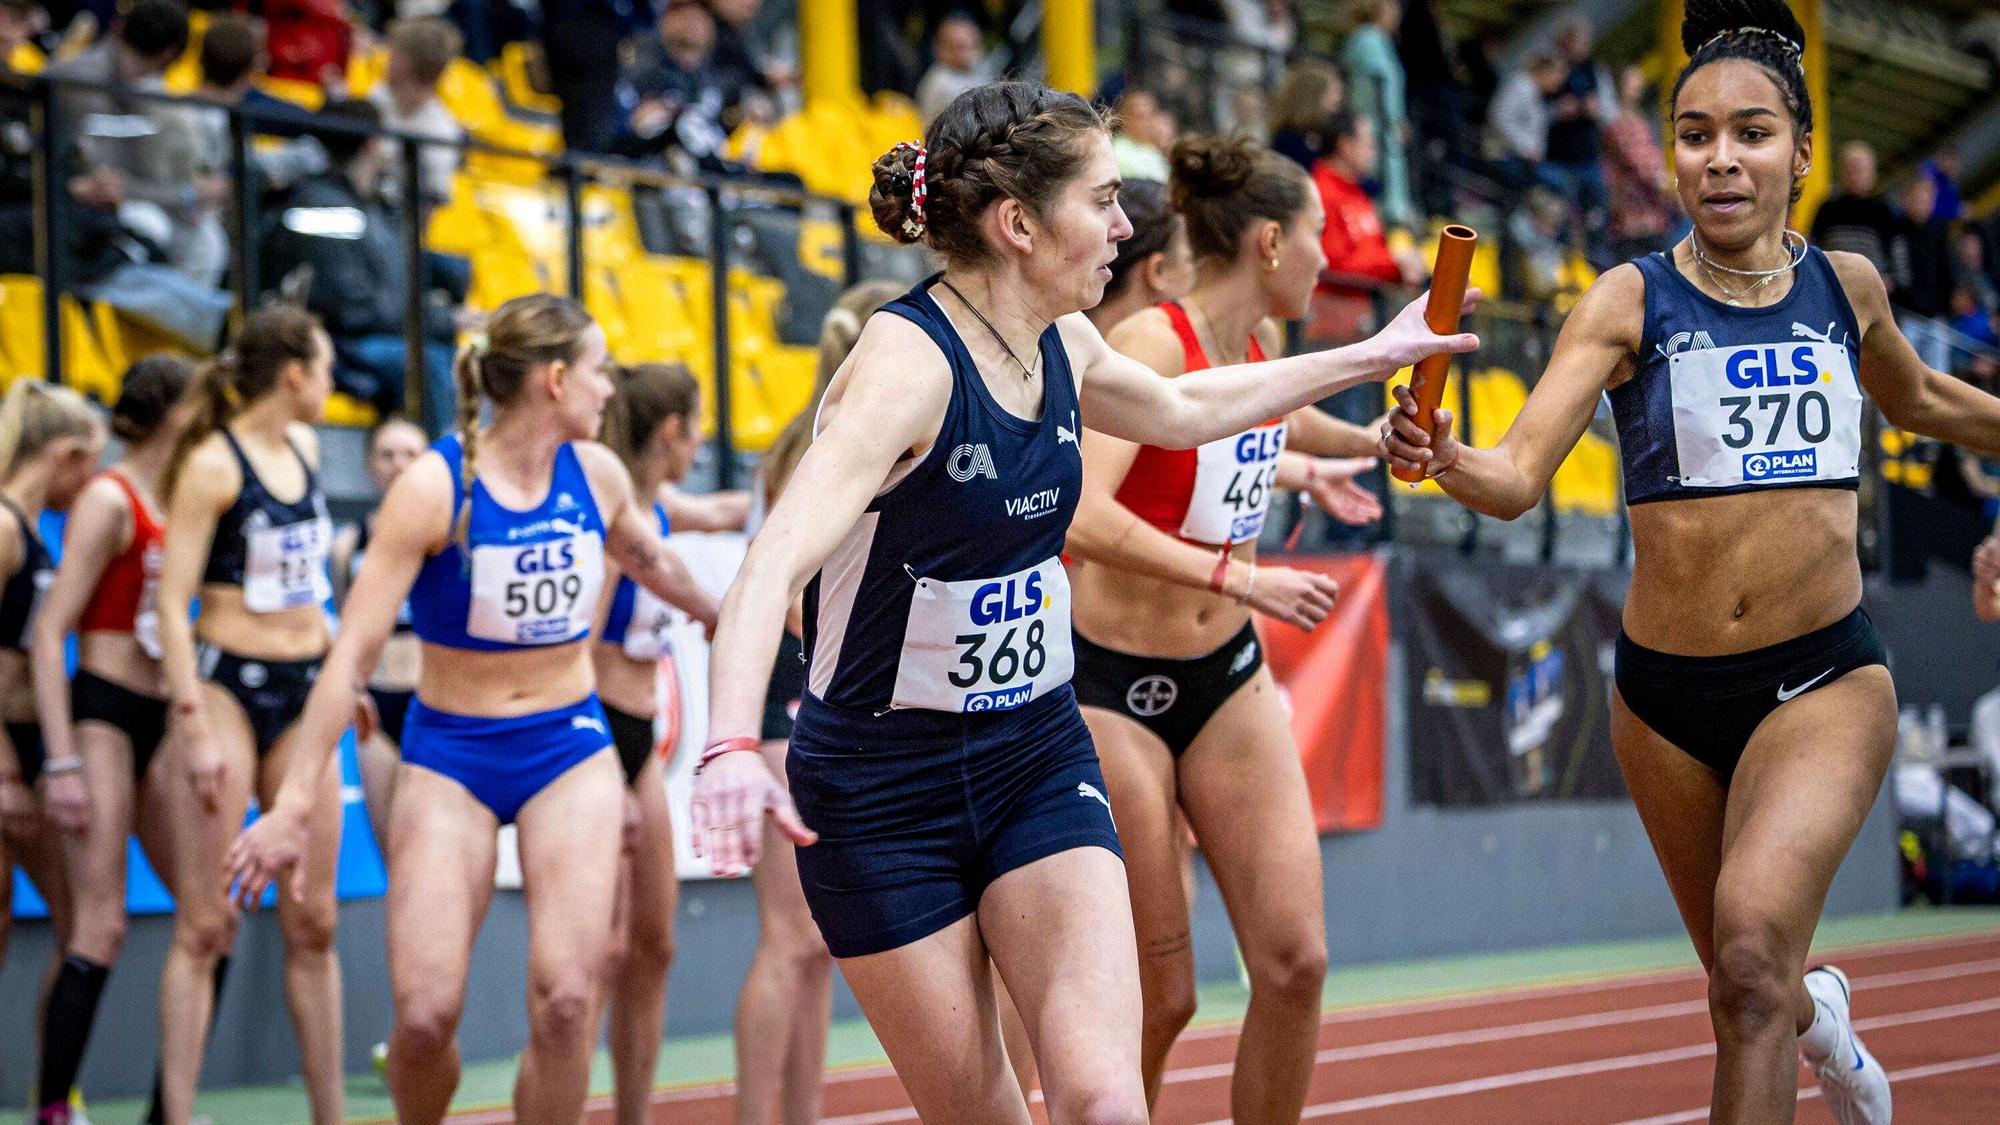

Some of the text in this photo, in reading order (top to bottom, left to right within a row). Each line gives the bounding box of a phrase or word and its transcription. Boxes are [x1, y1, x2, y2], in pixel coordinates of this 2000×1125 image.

[1720, 390, 1831, 449] 370
[1236, 428, 1283, 464] GLS
[1772, 454, 1813, 469] PLAN
[1005, 487, 1060, 516] VIACTIV
[505, 574, 581, 617] 509
[947, 619, 1046, 688] 368
[994, 689, 1030, 708] PLAN
